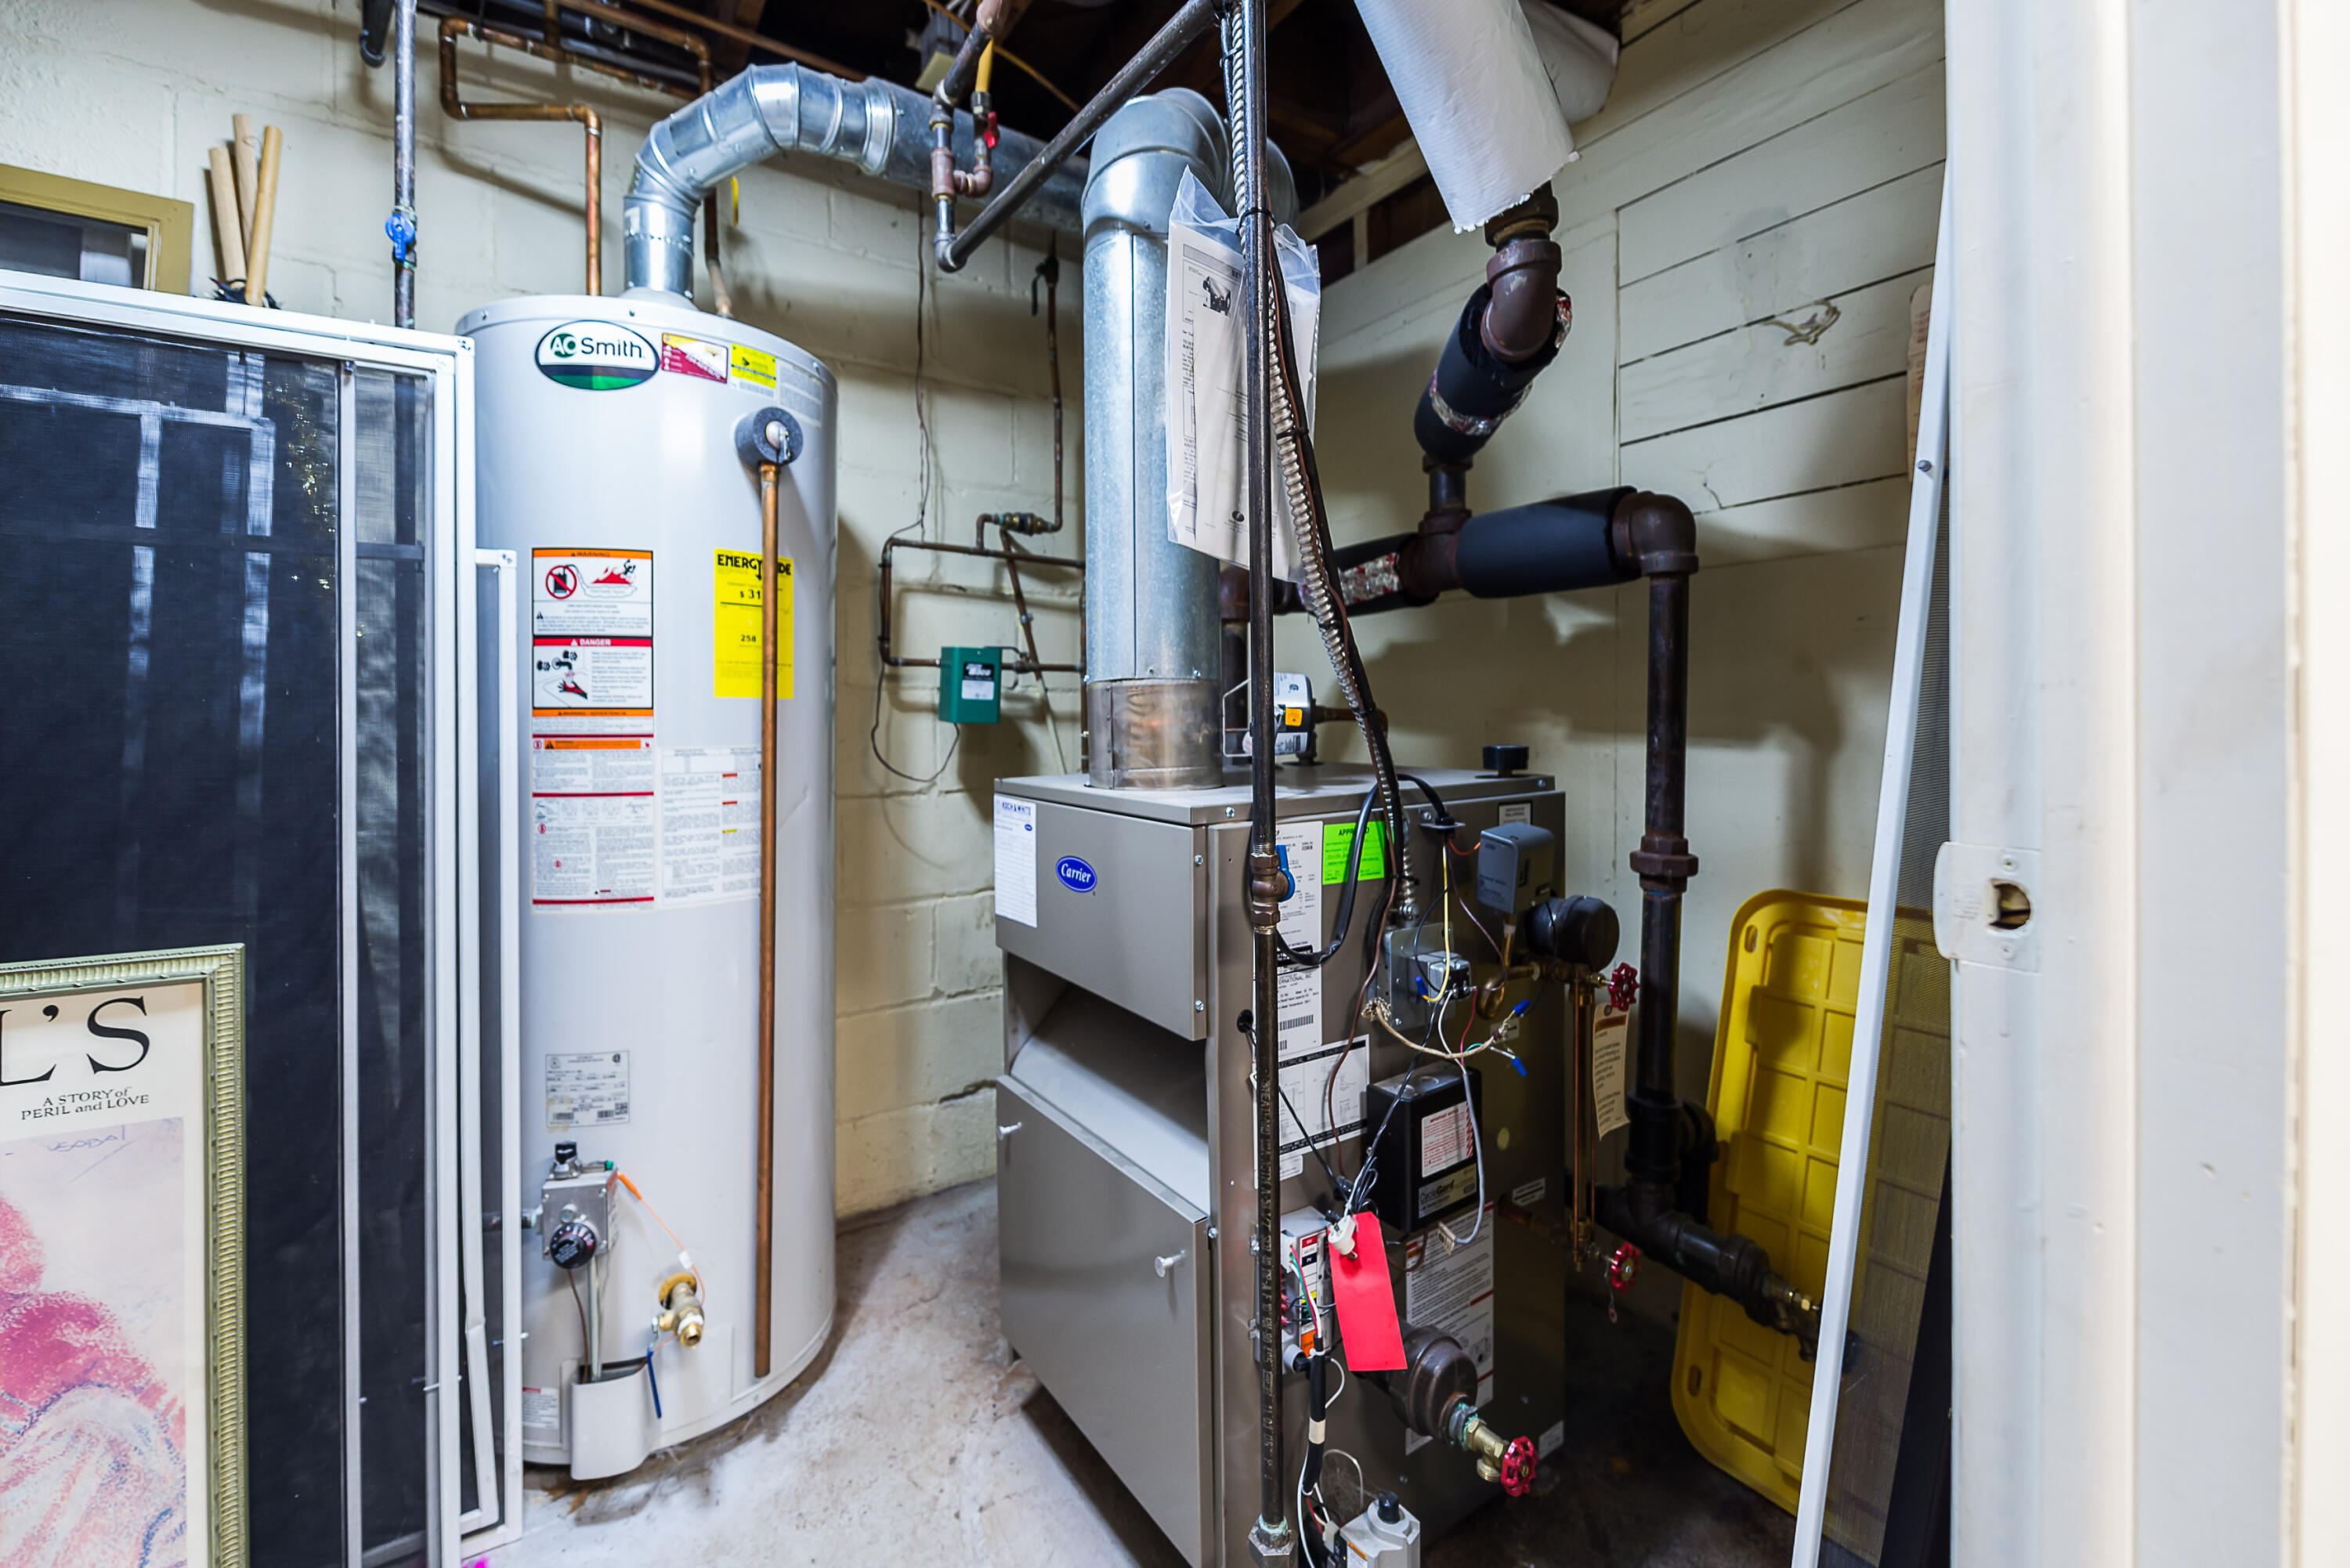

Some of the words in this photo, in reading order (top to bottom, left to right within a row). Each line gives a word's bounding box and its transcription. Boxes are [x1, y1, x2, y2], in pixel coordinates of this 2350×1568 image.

[581, 337, 642, 359] Smith
[1338, 826, 1370, 836] APPRD
[1061, 863, 1092, 884] Carrier
[21, 1104, 70, 1120] PERIL
[75, 1102, 102, 1113] and
[107, 1093, 150, 1109] LOVE
[42, 1097, 53, 1107] A
[58, 1089, 114, 1105] STORY
[114, 1086, 132, 1098] of
